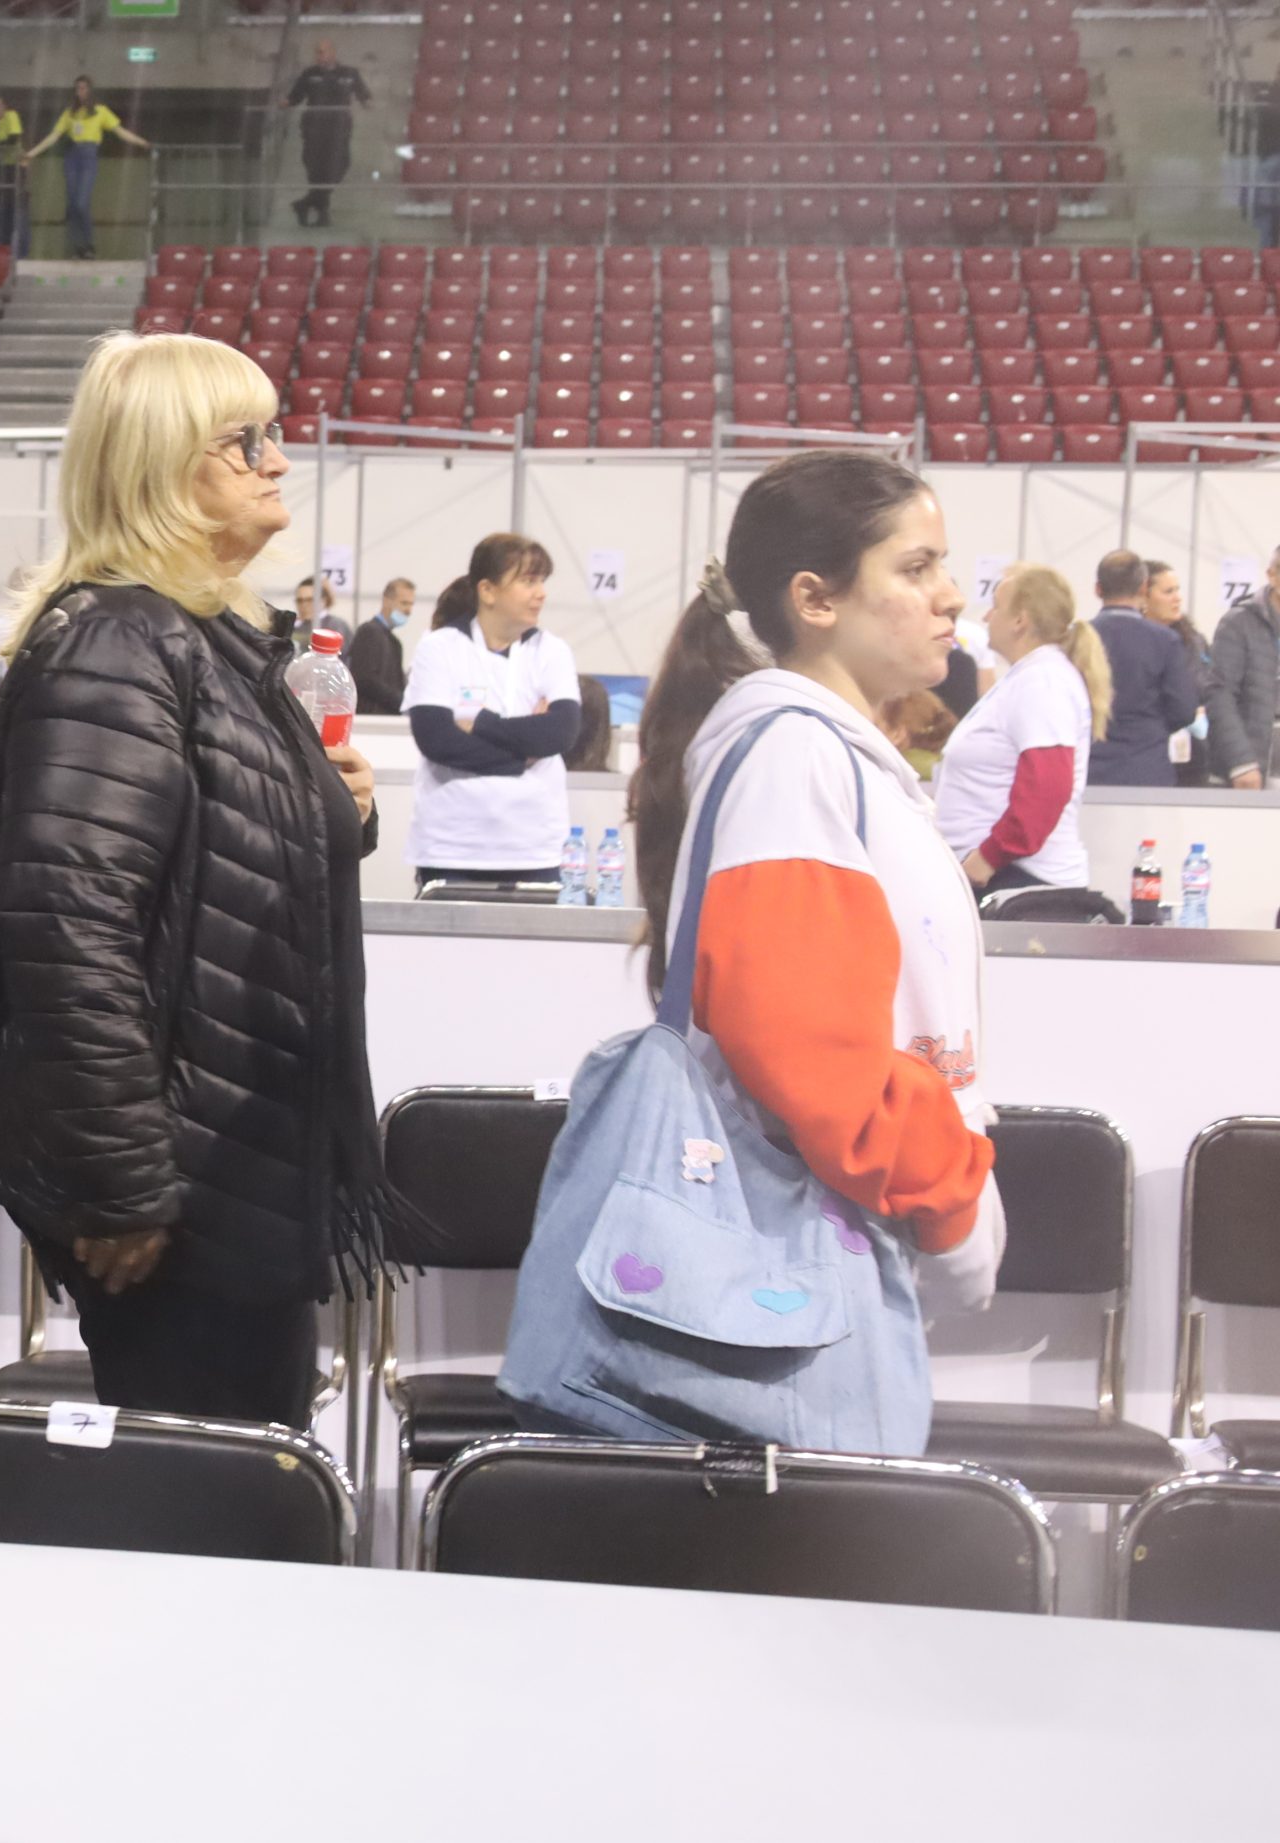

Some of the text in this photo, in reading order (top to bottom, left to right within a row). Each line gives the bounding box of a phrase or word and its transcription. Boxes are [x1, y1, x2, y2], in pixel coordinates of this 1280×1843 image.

[322, 569, 346, 586] 73
[593, 572, 617, 590] 74
[70, 1412, 98, 1434] 7
